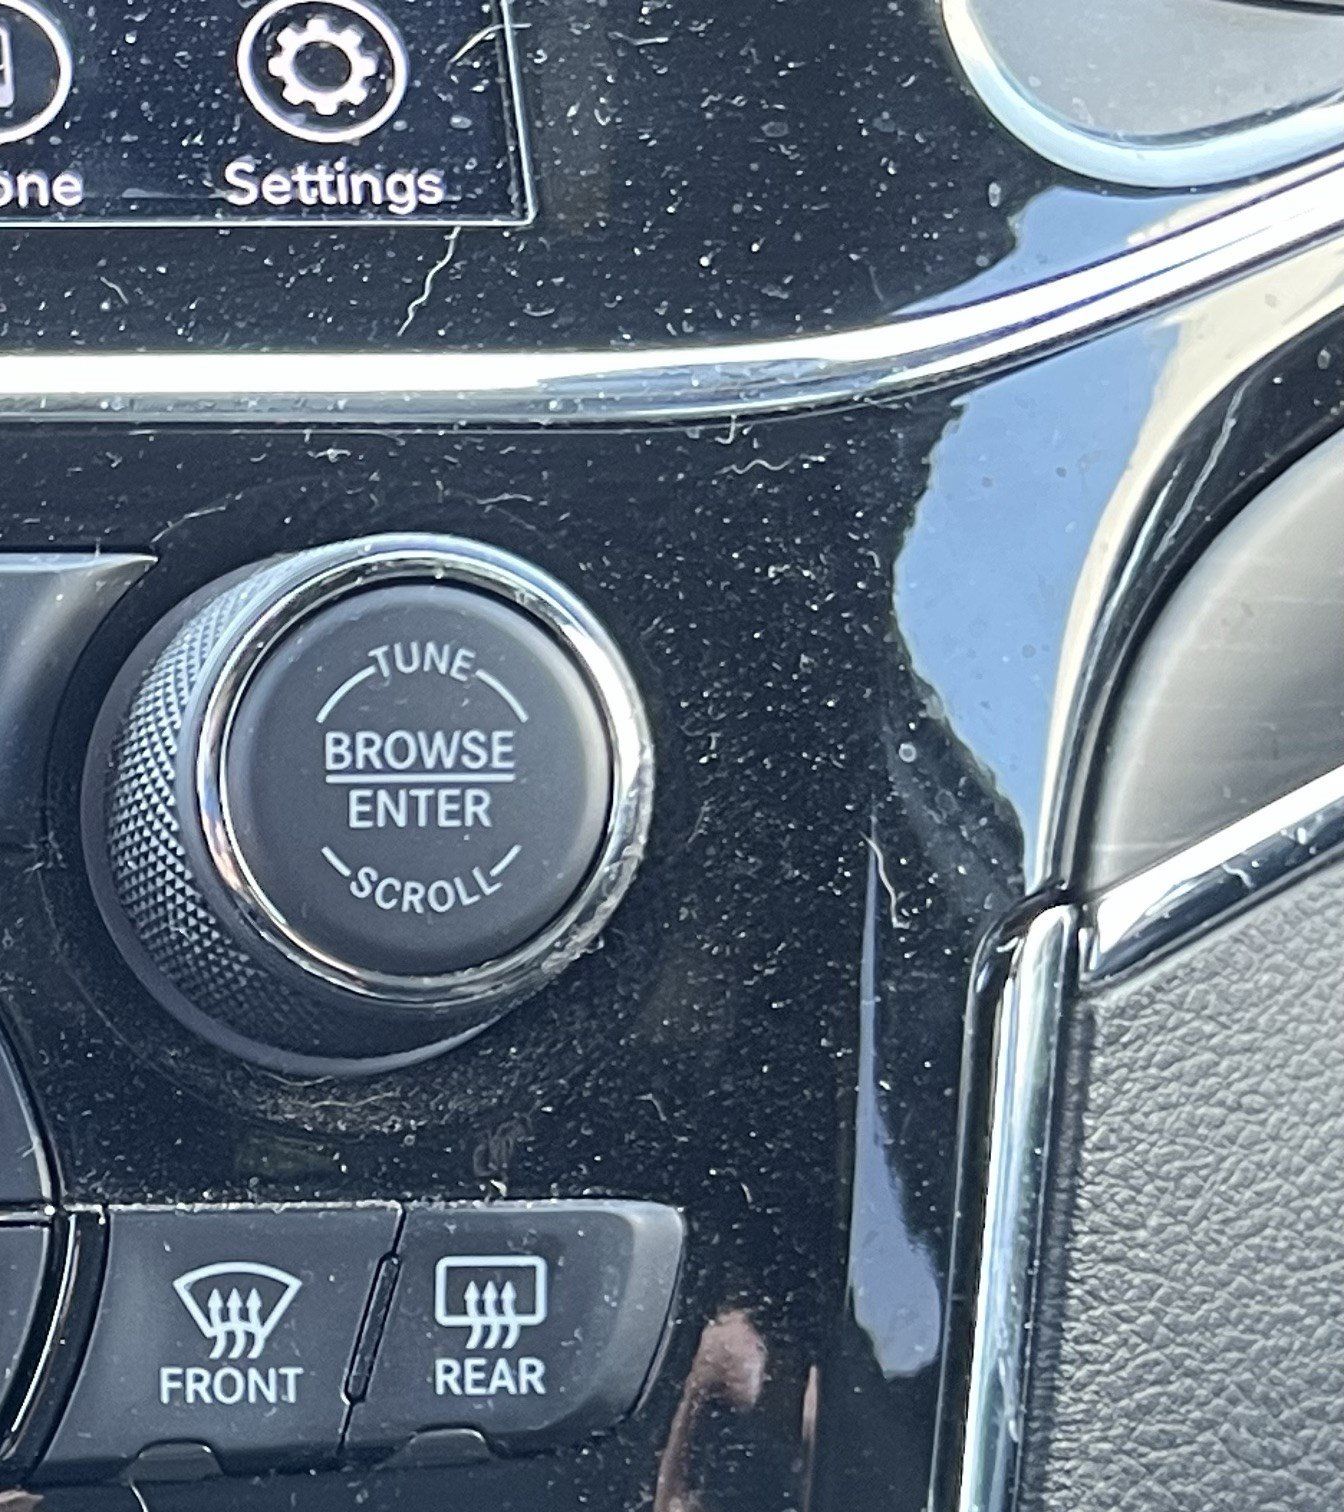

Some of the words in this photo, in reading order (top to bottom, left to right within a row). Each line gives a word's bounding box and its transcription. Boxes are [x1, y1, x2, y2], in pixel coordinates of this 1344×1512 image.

[224, 161, 445, 214] Settings
[368, 641, 477, 682] TUNE
[325, 729, 516, 771] BROWSE
[348, 788, 493, 829] ENTER
[349, 865, 503, 914] SCROLL
[159, 1366, 304, 1404] FRONT
[434, 1357, 546, 1396] REAR
